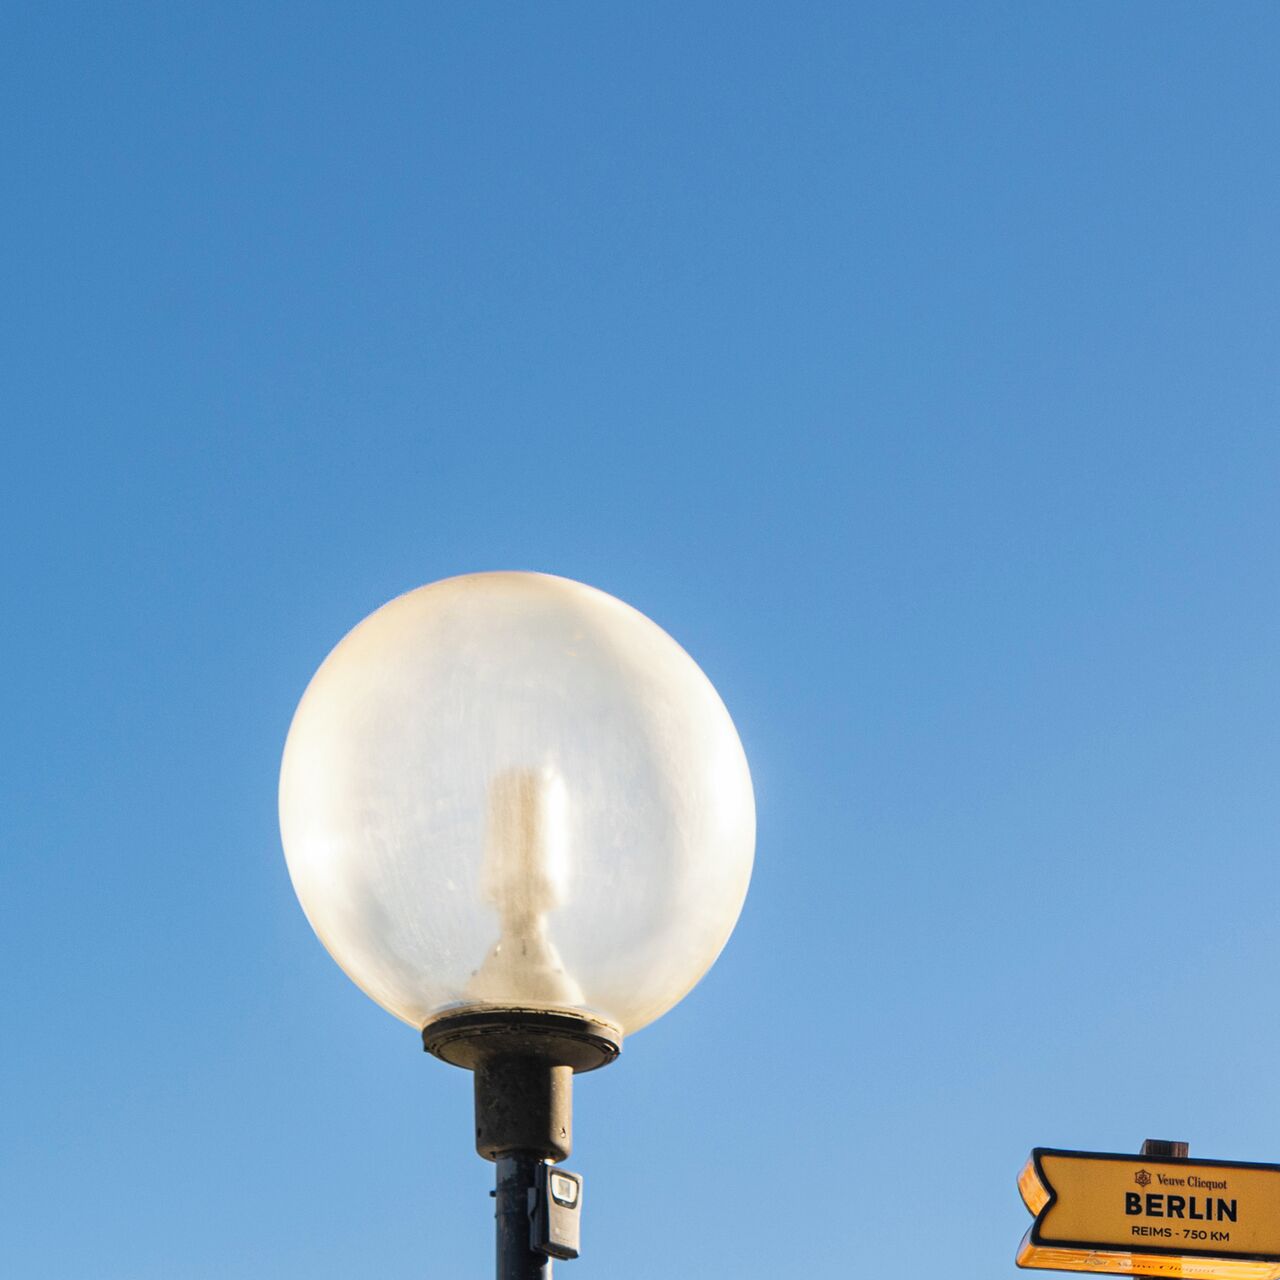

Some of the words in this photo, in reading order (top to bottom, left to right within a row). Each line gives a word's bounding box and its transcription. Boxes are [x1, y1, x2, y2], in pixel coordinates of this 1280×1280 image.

[1157, 1174, 1186, 1186] Veuve
[1187, 1176, 1228, 1191] Clicquot
[1126, 1192, 1236, 1222] BERLIN
[1132, 1226, 1172, 1237] REIMS
[1183, 1230, 1207, 1240] 750
[1211, 1232, 1229, 1241] KM
